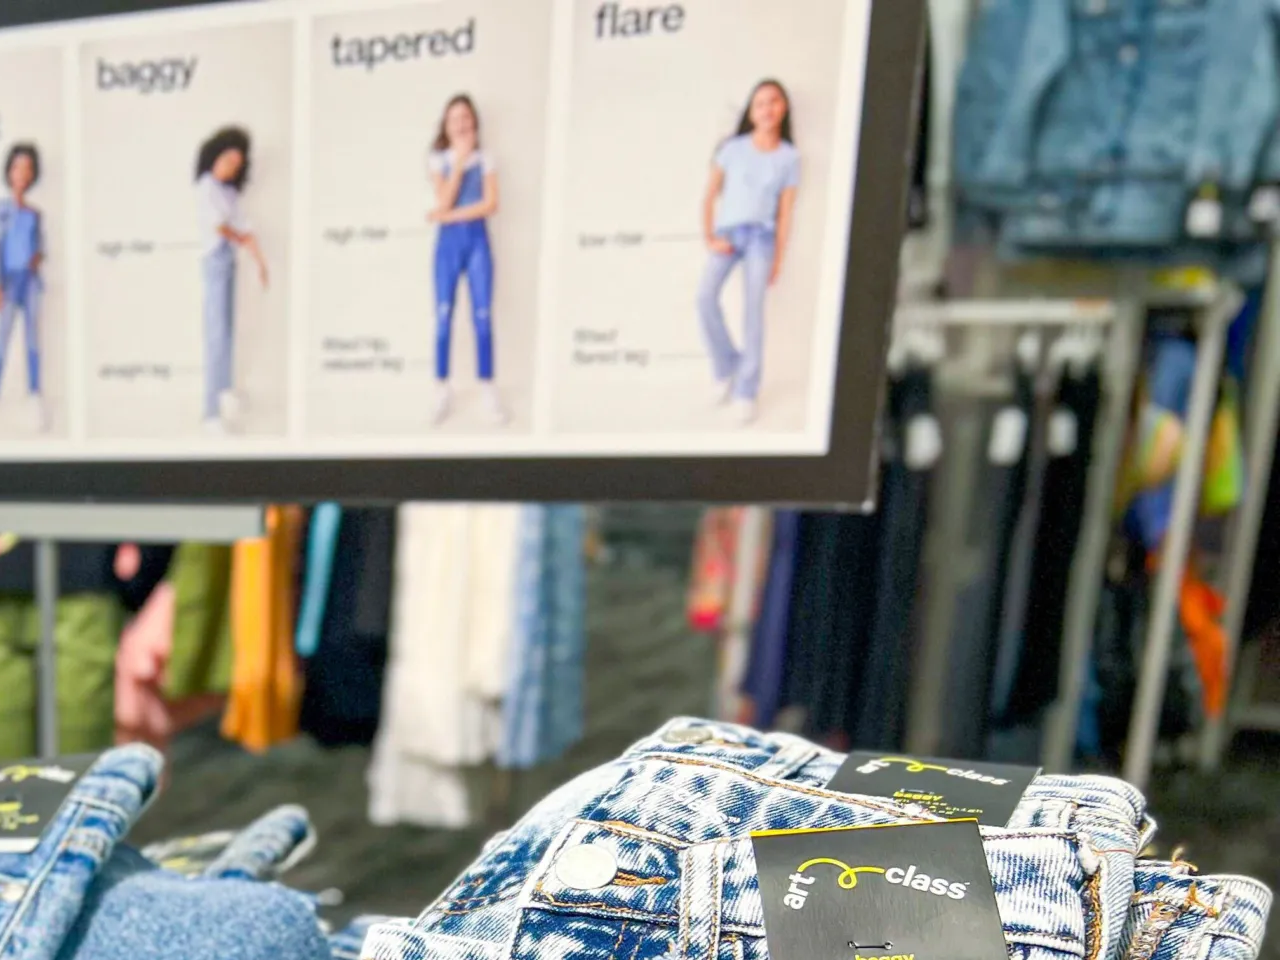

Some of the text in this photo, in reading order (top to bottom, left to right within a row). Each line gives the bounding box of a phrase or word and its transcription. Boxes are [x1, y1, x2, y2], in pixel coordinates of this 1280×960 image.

[594, 2, 685, 39] flare
[330, 18, 476, 70] tapered
[96, 54, 197, 94] baggy
[946, 768, 1008, 785] class
[783, 865, 967, 910] art class
